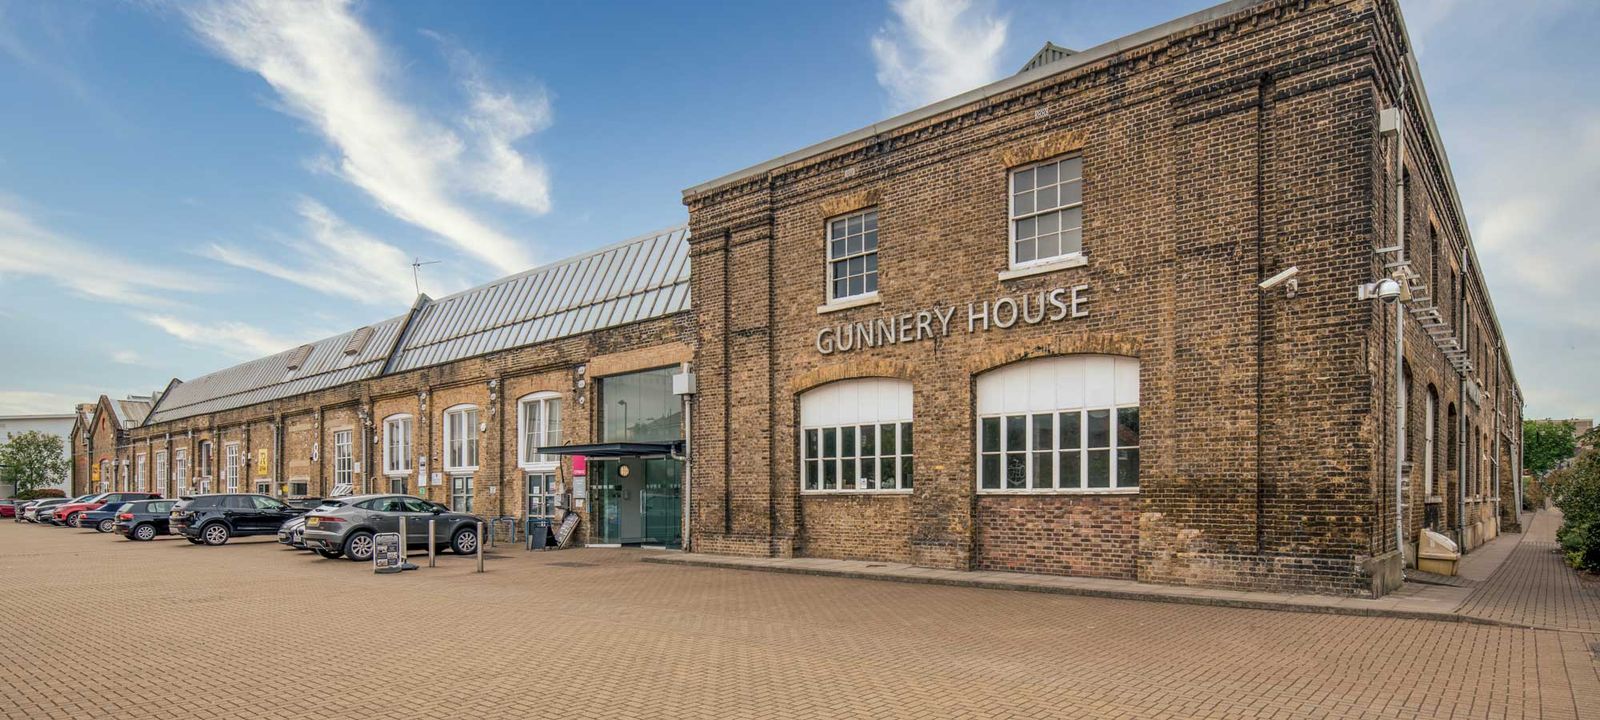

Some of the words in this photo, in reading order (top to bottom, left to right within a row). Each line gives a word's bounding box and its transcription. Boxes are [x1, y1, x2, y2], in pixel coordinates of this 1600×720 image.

[816, 306, 956, 355] GUNNERY
[968, 284, 1090, 333] HOUSE
[313, 442, 319, 462] 8
